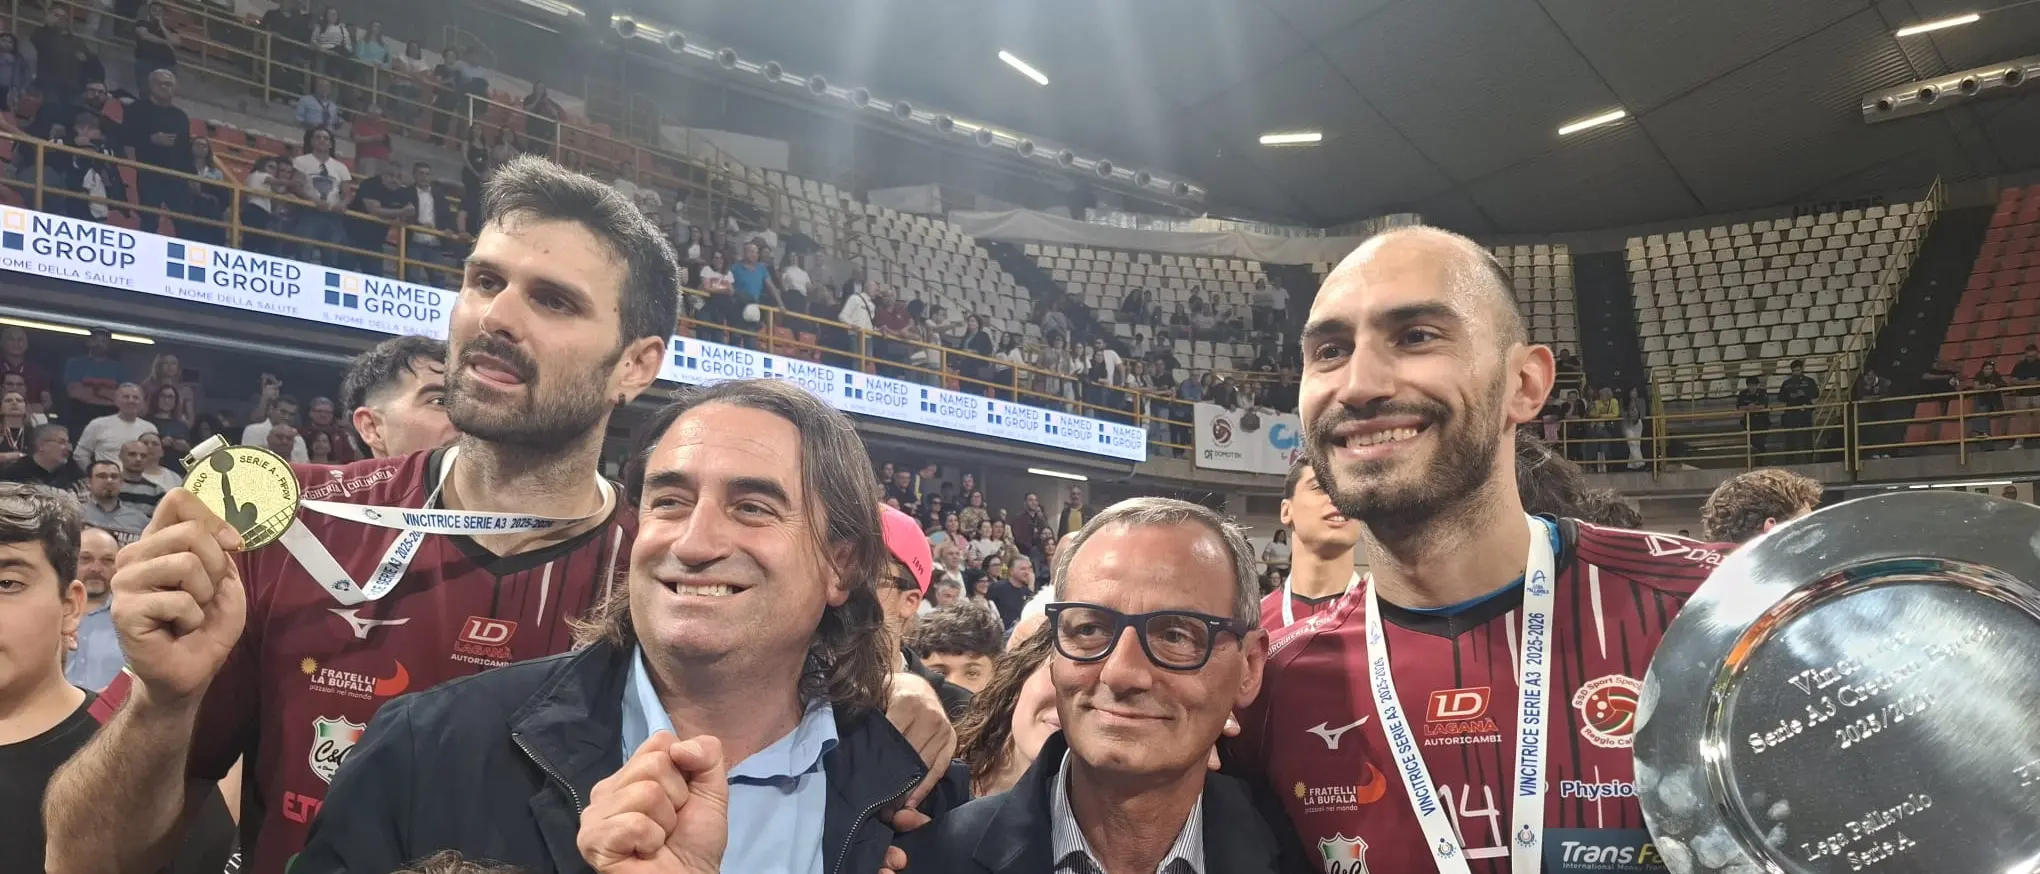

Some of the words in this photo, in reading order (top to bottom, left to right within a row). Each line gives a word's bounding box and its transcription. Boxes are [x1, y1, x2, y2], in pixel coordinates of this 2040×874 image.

[32, 215, 136, 250] NAMED
[32, 237, 136, 269] GROUP
[0, 257, 32, 270] OME
[38, 263, 80, 278] DELLA
[84, 271, 134, 287] SALUTE
[213, 250, 301, 280] NAMED
[213, 270, 300, 299] GROUP
[365, 279, 441, 306] NAMED
[178, 287, 213, 301] NOME
[217, 293, 253, 307] DELLA
[257, 301, 299, 315] SALUTE
[364, 297, 441, 322] GROUP
[701, 345, 754, 366] NAMED
[701, 360, 754, 379] GROUP
[787, 361, 834, 381] NAMED
[866, 378, 908, 396] NAMED
[866, 391, 908, 408] GROUP
[940, 392, 978, 409] NAMED
[940, 404, 978, 420] GROUP
[1005, 405, 1039, 421] NAMED
[1005, 416, 1039, 431] GROUP
[1061, 416, 1092, 430] NAMED
[1061, 427, 1092, 440] GROUP
[1113, 426, 1142, 440] NAMED
[1113, 438, 1142, 450] GROUP
[239, 455, 270, 470] SERIE
[268, 467, 276, 476] A
[277, 477, 291, 501] FIPAV
[347, 470, 393, 491] CULINARIA
[403, 512, 461, 529] VINCITRICE
[464, 516, 493, 529] SERIE
[494, 518, 507, 529] A3
[1527, 612, 1544, 665] 2025-2026
[450, 653, 512, 667] AUTORICAMB
[311, 674, 325, 684] LA
[328, 679, 373, 693] BUFALA
[320, 667, 376, 685] FRATELLI
[1374, 656, 1392, 704] 2025-2026
[1525, 671, 1541, 687] A3
[1587, 677, 1613, 690] Sport
[336, 688, 347, 696] nel
[348, 690, 373, 700] mondo
[1386, 706, 1399, 721] A3
[1524, 689, 1541, 725] SERIE
[1748, 718, 1803, 754] Serie
[1806, 695, 1837, 728] A3
[1389, 720, 1412, 753] SERIE
[1424, 734, 1502, 746] AUTORICAMBI
[1585, 728, 1615, 745] Reggio
[1520, 729, 1539, 796] VINCITRICE
[1309, 785, 1357, 796] FRATELLI
[1402, 754, 1436, 817] VINCITRICE
[1561, 779, 1637, 801] Physio
[1304, 797, 1315, 805] LA
[1317, 795, 1357, 804] BUFALA
[1845, 793, 1932, 841] Pallavolo
[1561, 841, 1635, 864] Trans
[1847, 841, 1895, 871] Serie
[1898, 831, 1916, 851] A
